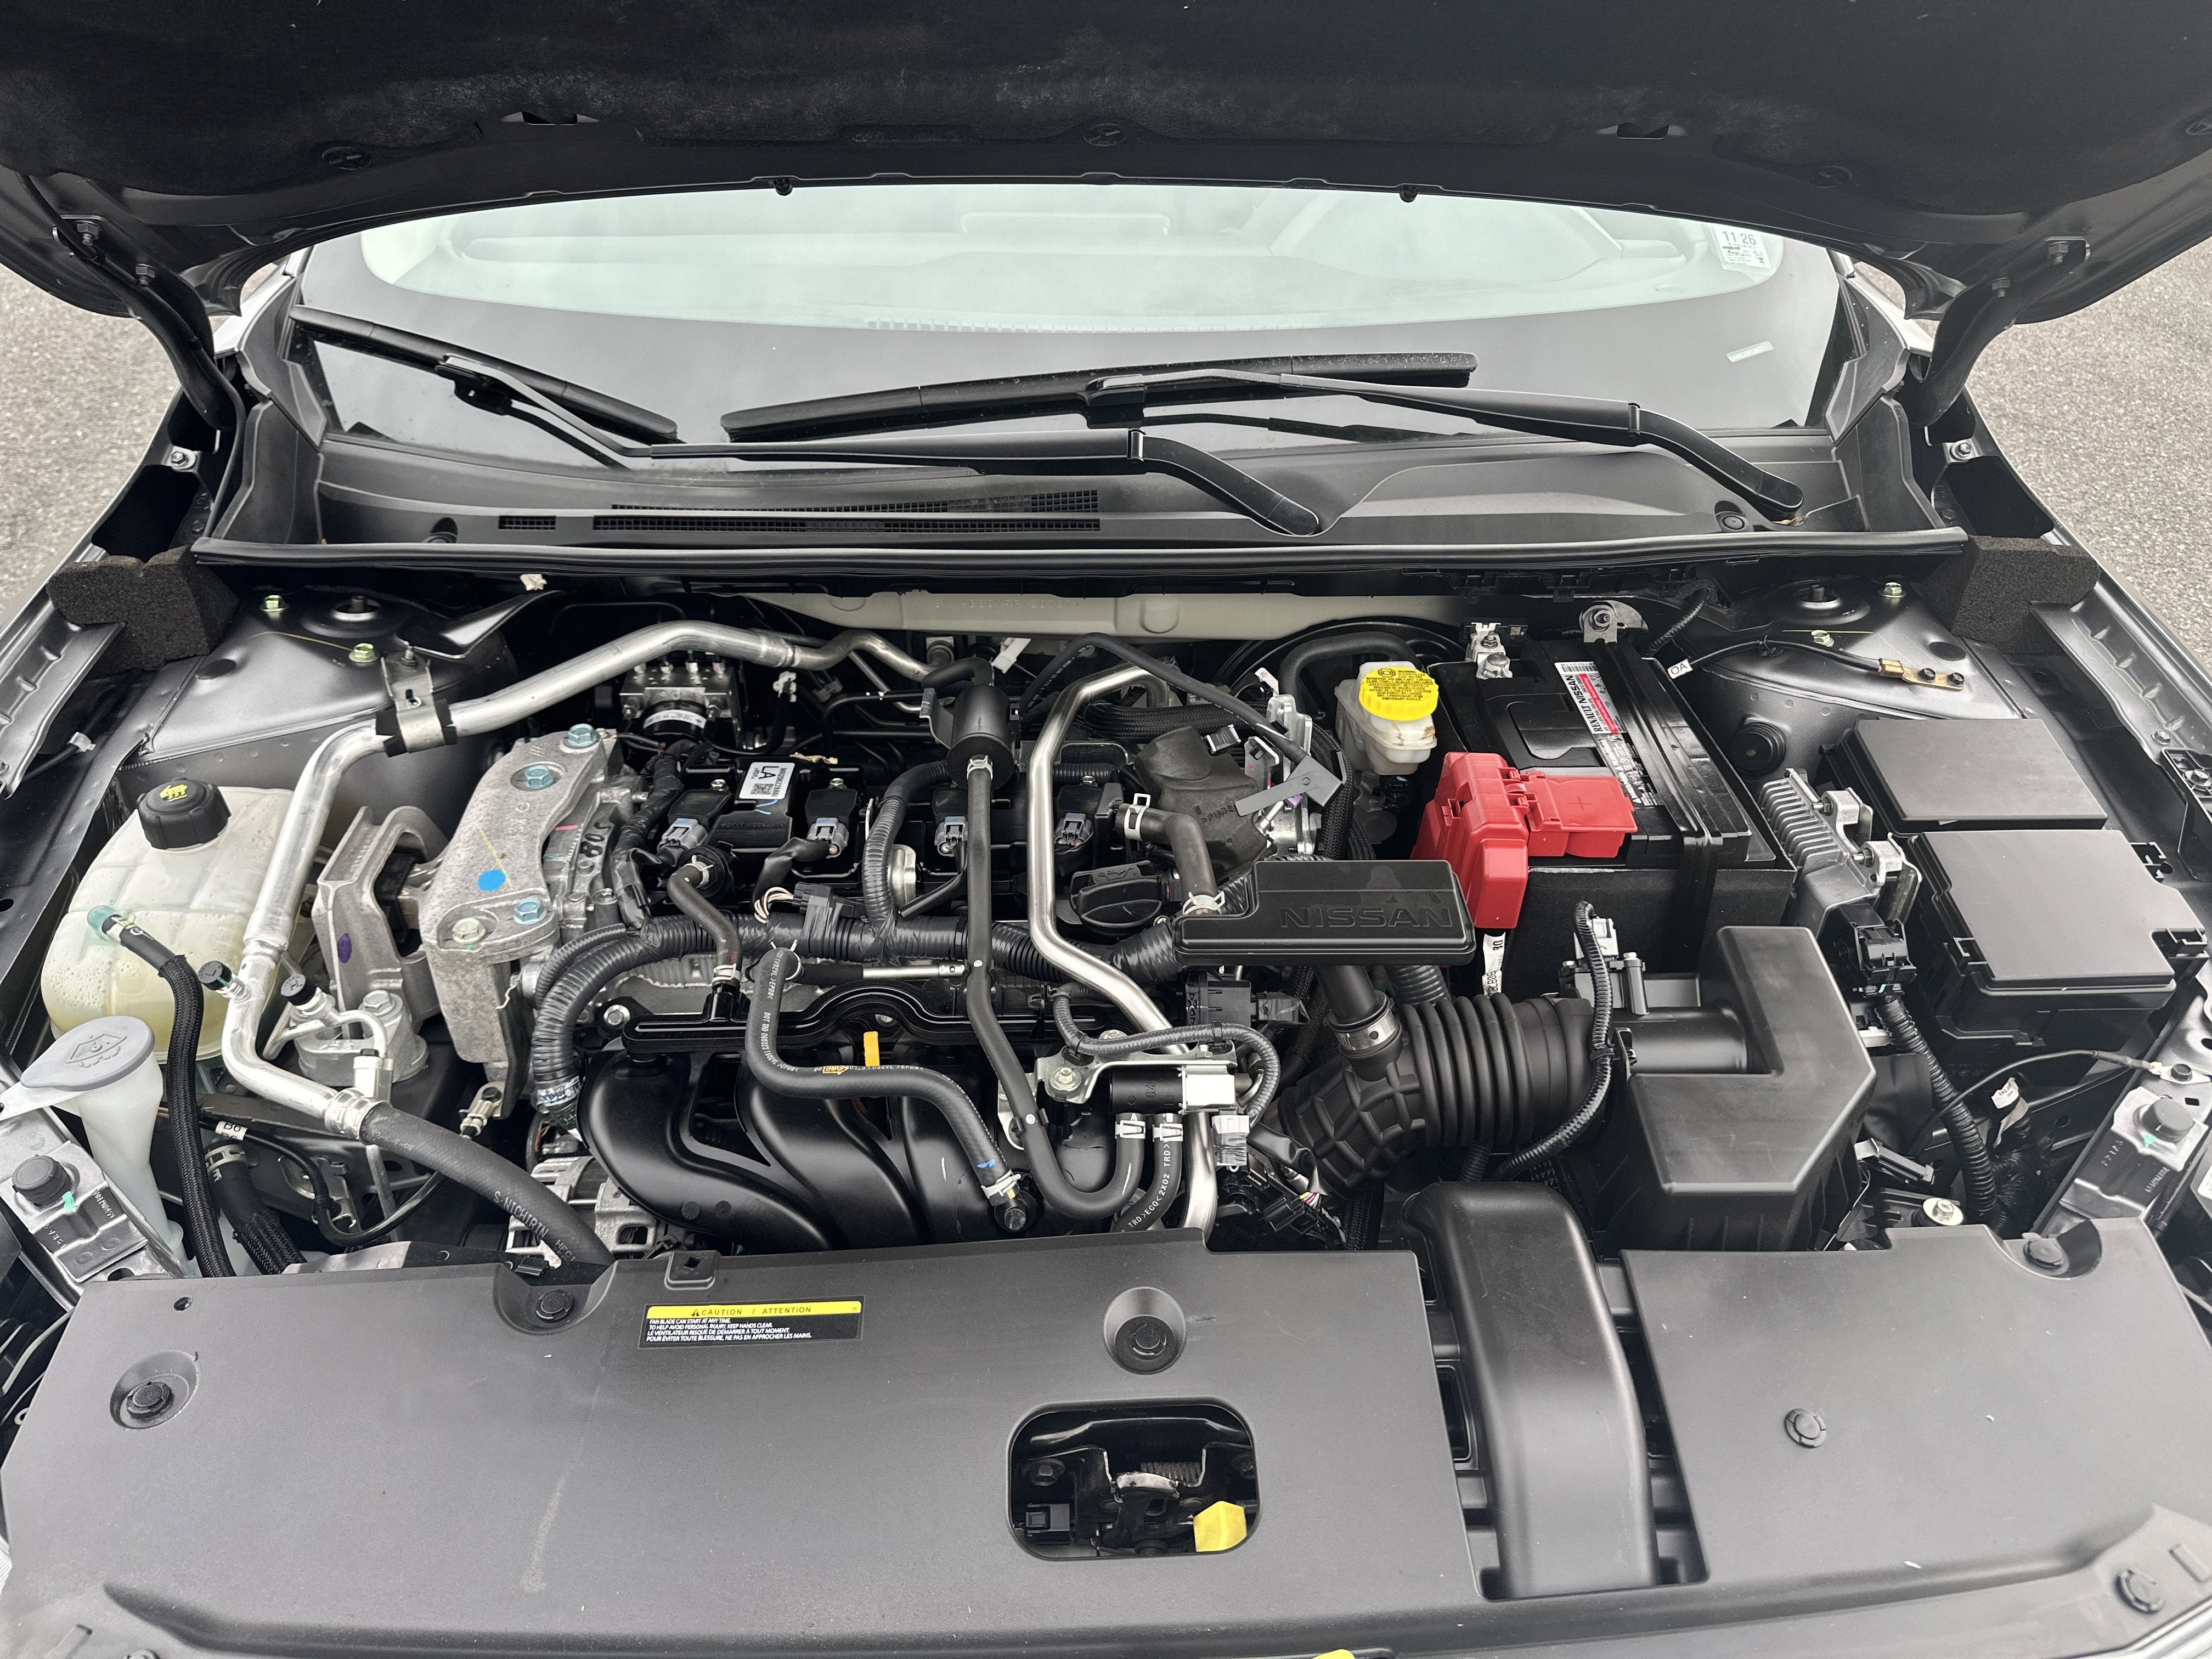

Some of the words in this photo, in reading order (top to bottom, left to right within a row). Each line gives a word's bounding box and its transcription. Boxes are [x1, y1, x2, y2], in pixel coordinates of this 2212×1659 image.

[1567, 674, 1587, 704] NISSAN
[1581, 704, 1604, 733] RENAULT
[758, 766, 779, 780] LA
[1279, 907, 1453, 928] NISSAN
[763, 1012, 771, 1023] DOT
[223, 1121, 241, 1132] B6
[762, 1306, 811, 1314] ATTENTION
